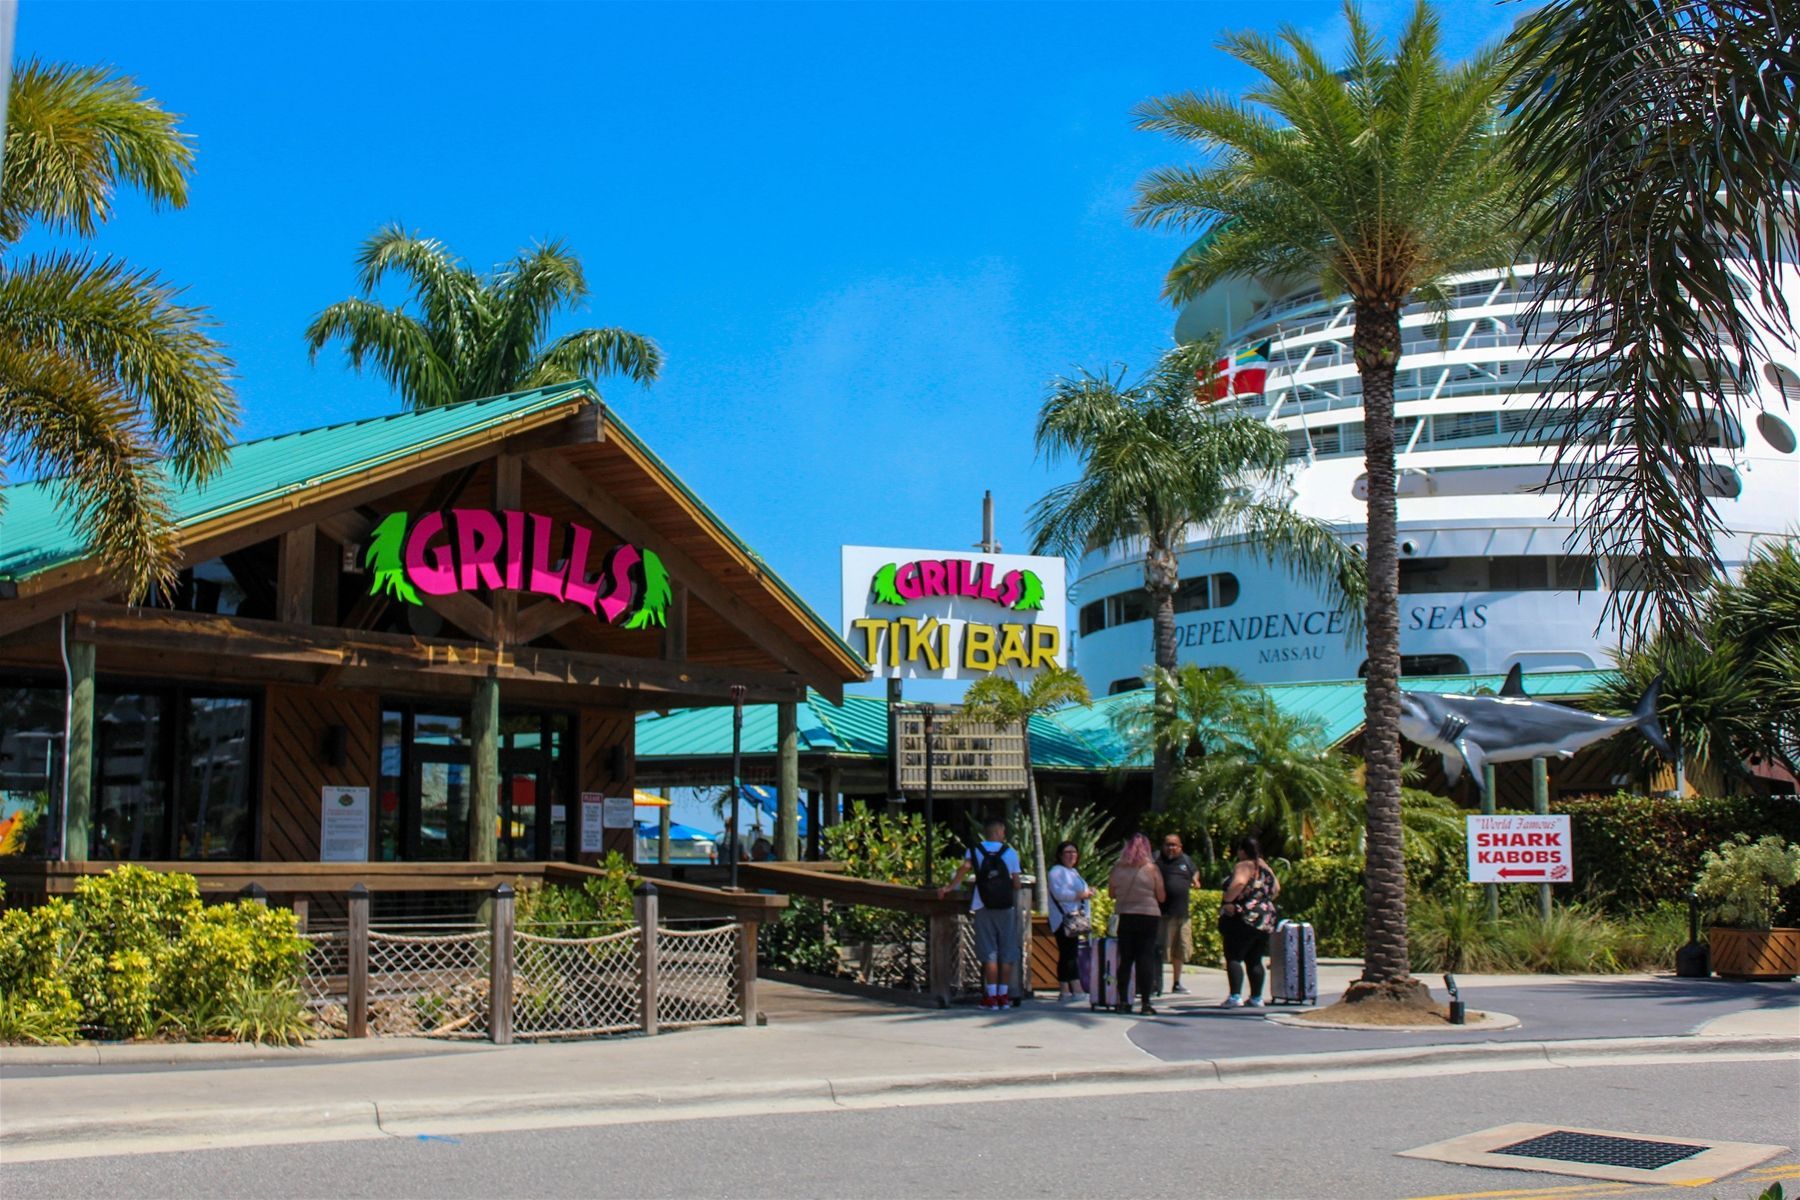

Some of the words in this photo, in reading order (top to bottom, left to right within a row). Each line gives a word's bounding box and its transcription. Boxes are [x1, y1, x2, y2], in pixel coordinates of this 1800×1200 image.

[405, 508, 642, 624] GRILLS
[895, 559, 1023, 607] GRILLS
[1151, 610, 1345, 652] IDEPENDENCE
[1409, 604, 1488, 631] SEAS
[853, 616, 951, 671] TIKI
[963, 622, 1060, 672] BAR
[1258, 646, 1326, 664] NASSAU
[904, 737, 921, 750] SAT
[905, 753, 922, 766] SUN
[931, 753, 951, 766] EREK
[955, 753, 975, 766] AND
[978, 753, 993, 766] THE
[942, 769, 989, 781] SLAMMERS
[1476, 832, 1562, 847] SHARK
[1477, 850, 1562, 864] KABOBS
